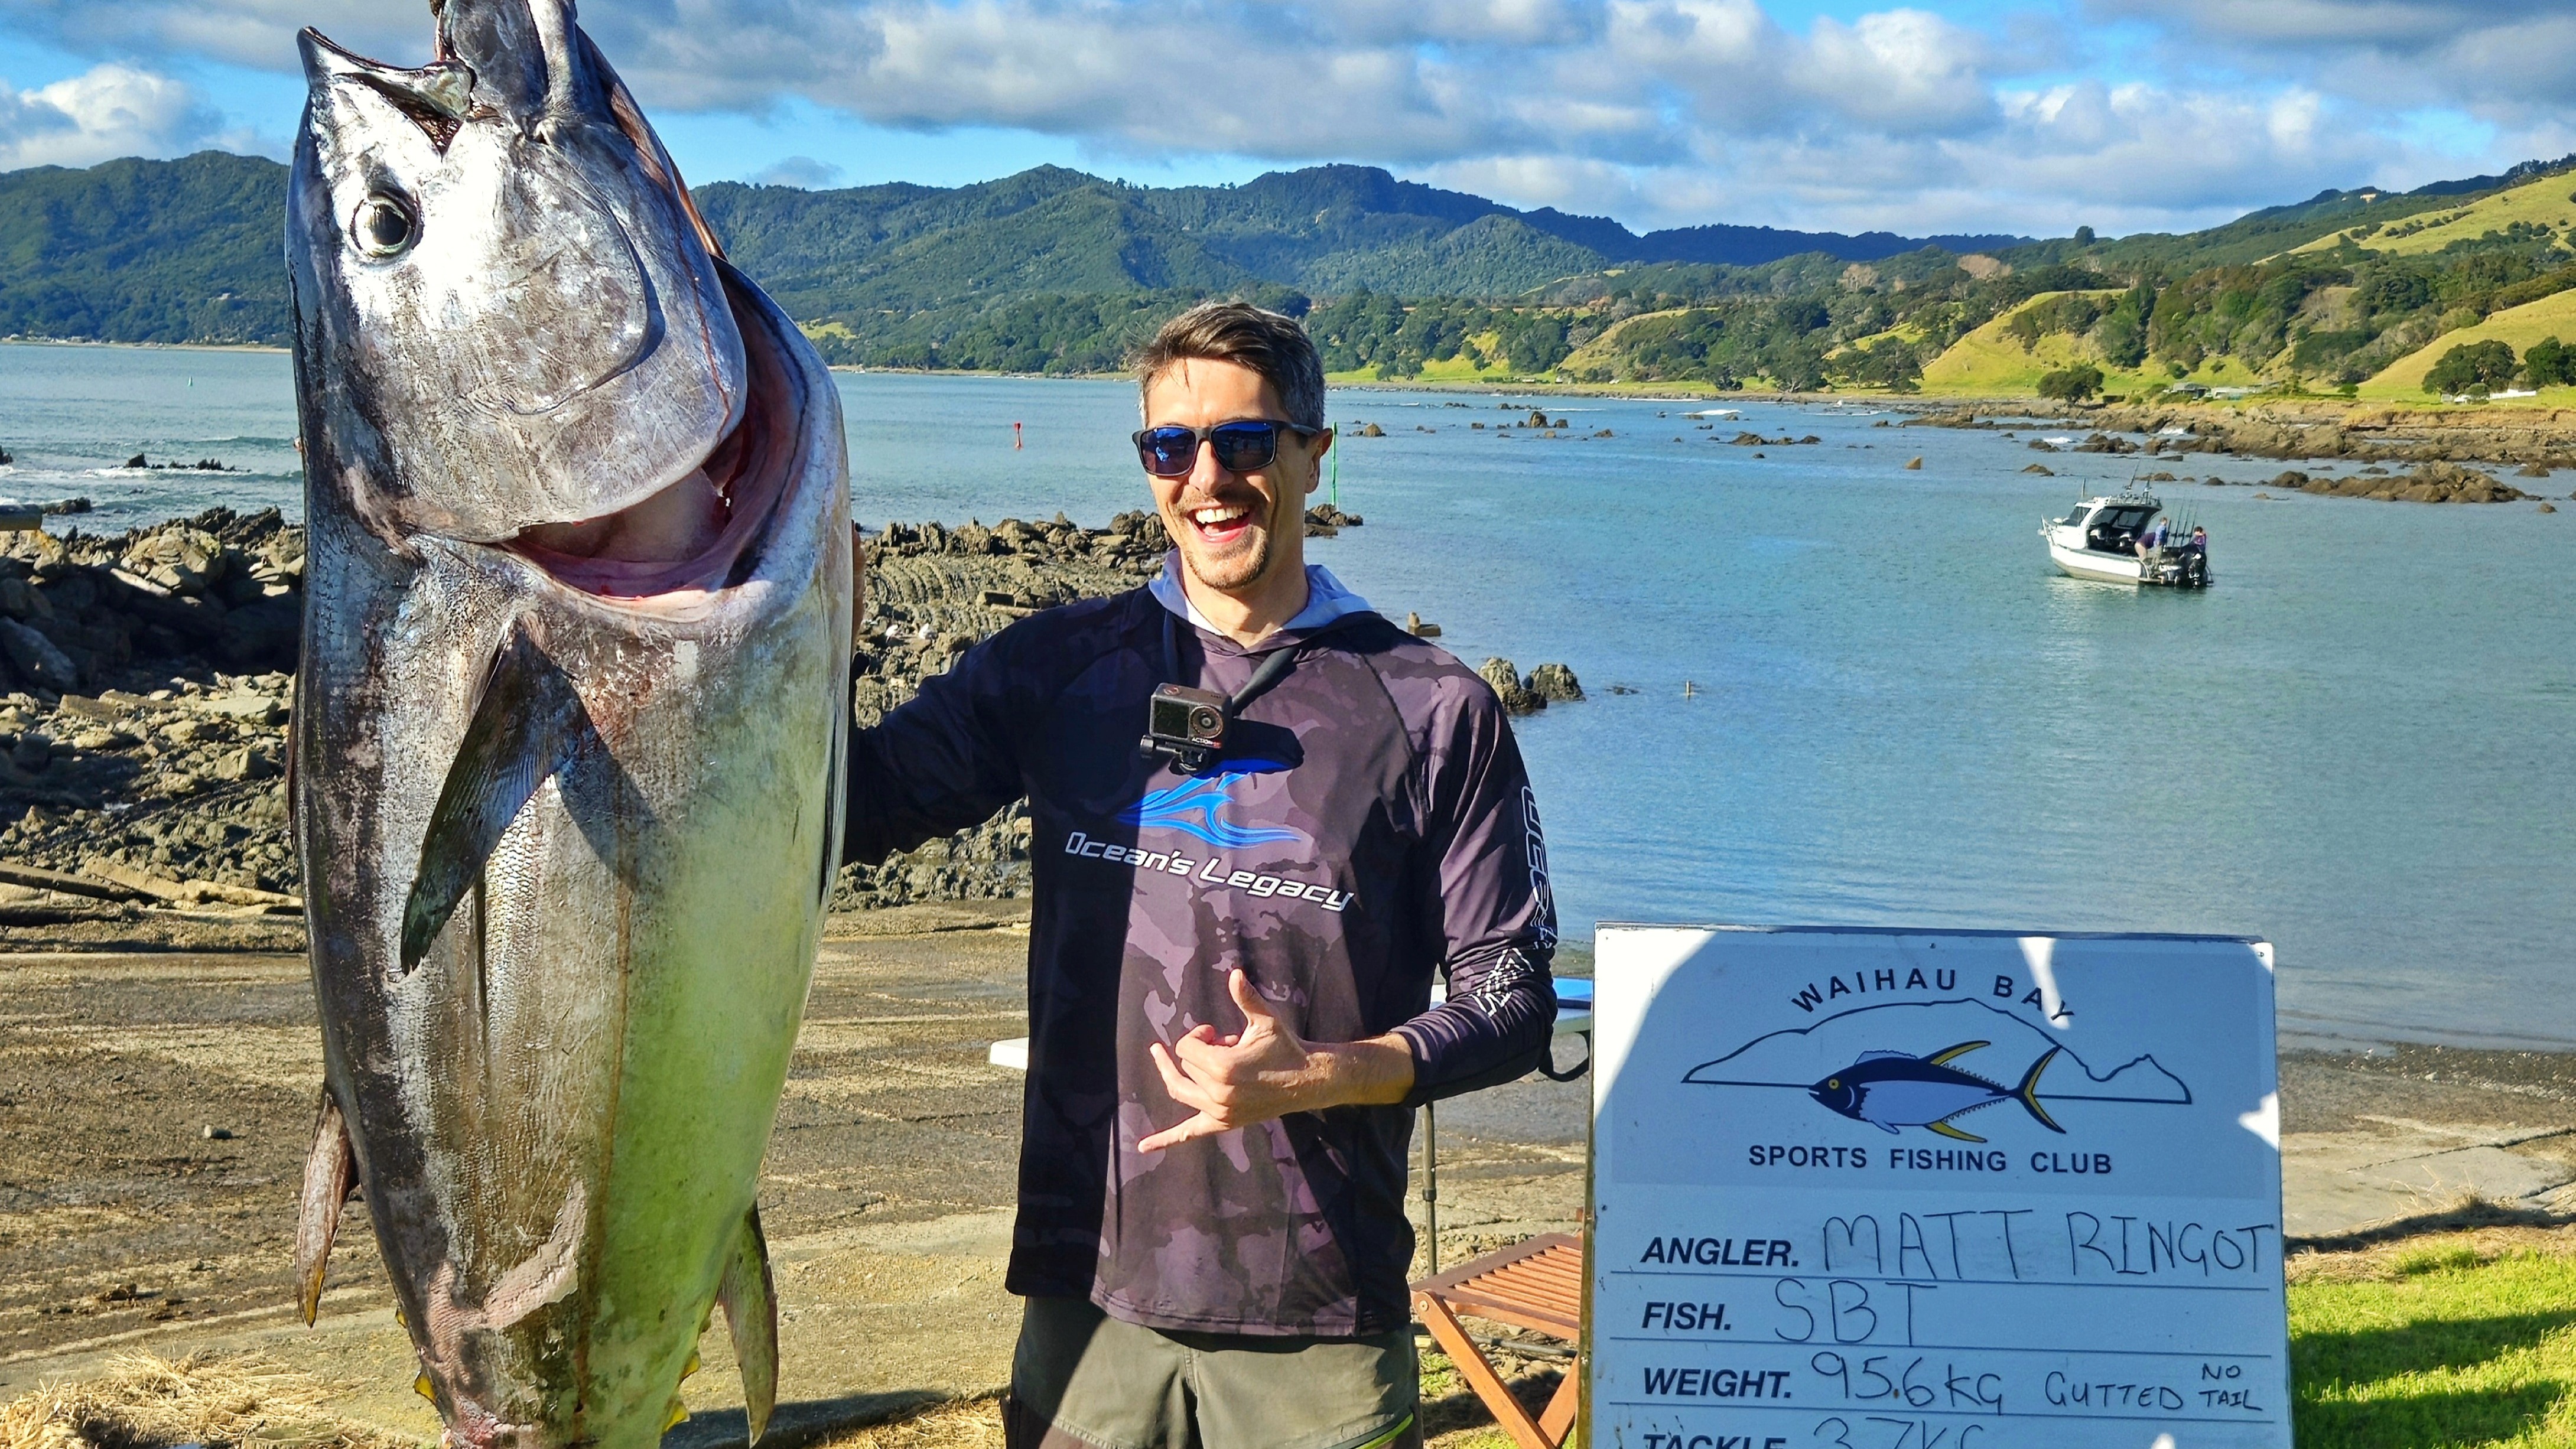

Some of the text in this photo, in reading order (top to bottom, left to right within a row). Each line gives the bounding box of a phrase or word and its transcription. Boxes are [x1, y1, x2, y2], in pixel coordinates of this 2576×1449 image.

[1065, 831, 1355, 912] Ocean's Legacy
[1791, 968, 2074, 1021] WAIHAU BAY
[1748, 1145, 2112, 1174] SPORTS FISHING CLUB
[1640, 1236, 1799, 1266] ANGLER.
[1823, 1209, 2274, 1279] MATT RINGOT
[1641, 1302, 1731, 1330] FISH.
[1775, 1278, 1938, 1347] SBT
[1644, 1367, 1791, 1398] WEIGHT.
[2201, 1363, 2241, 1380] NO
[2045, 1370, 2184, 1411] GUTTED
[2198, 1388, 2263, 1411] TAIL
